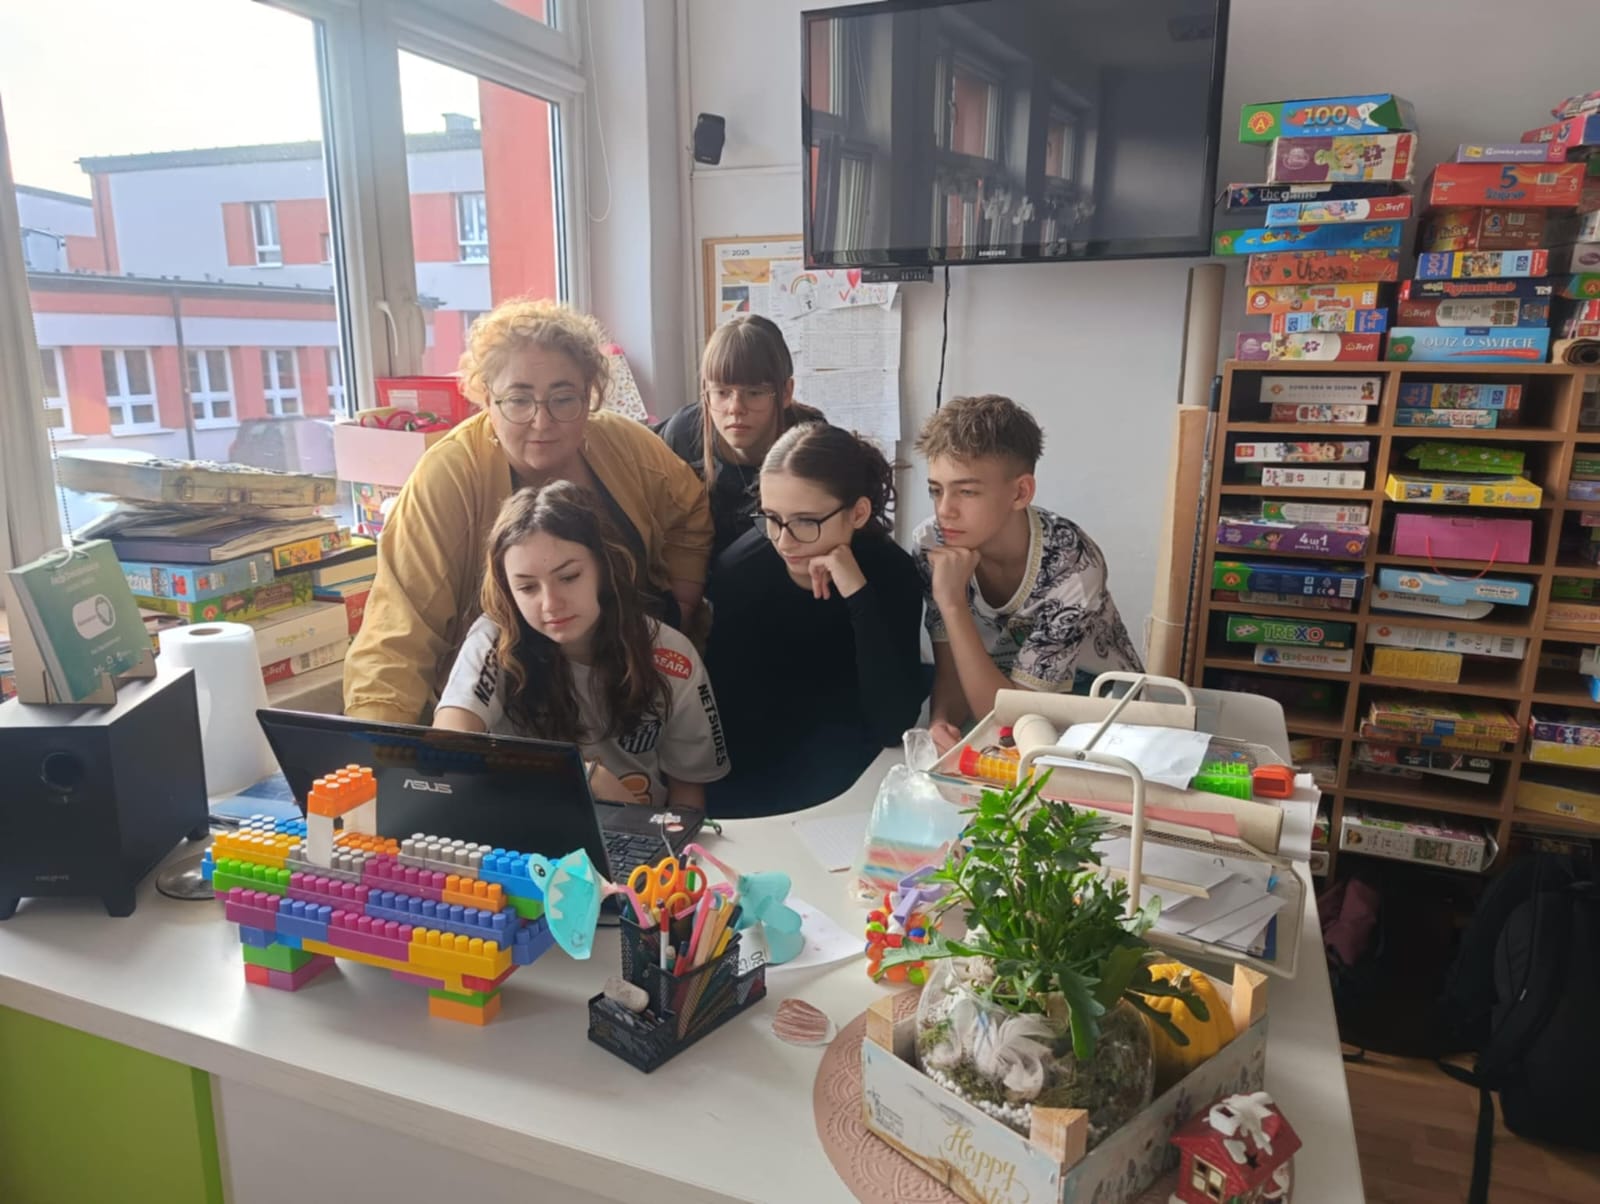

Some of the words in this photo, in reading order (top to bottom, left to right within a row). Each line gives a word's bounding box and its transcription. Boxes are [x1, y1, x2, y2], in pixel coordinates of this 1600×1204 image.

[1303, 105, 1348, 127] 100
[1501, 166, 1518, 189] 5
[1259, 189, 1280, 201] The
[1281, 191, 1318, 201] game
[732, 249, 751, 257] 2025
[1263, 623, 1325, 643] TREXO
[474, 640, 498, 707] NETS
[654, 654, 690, 678] SEARA
[697, 683, 728, 767] NETSHOES
[403, 778, 453, 794] ASUS
[942, 1118, 1017, 1193] Happy
